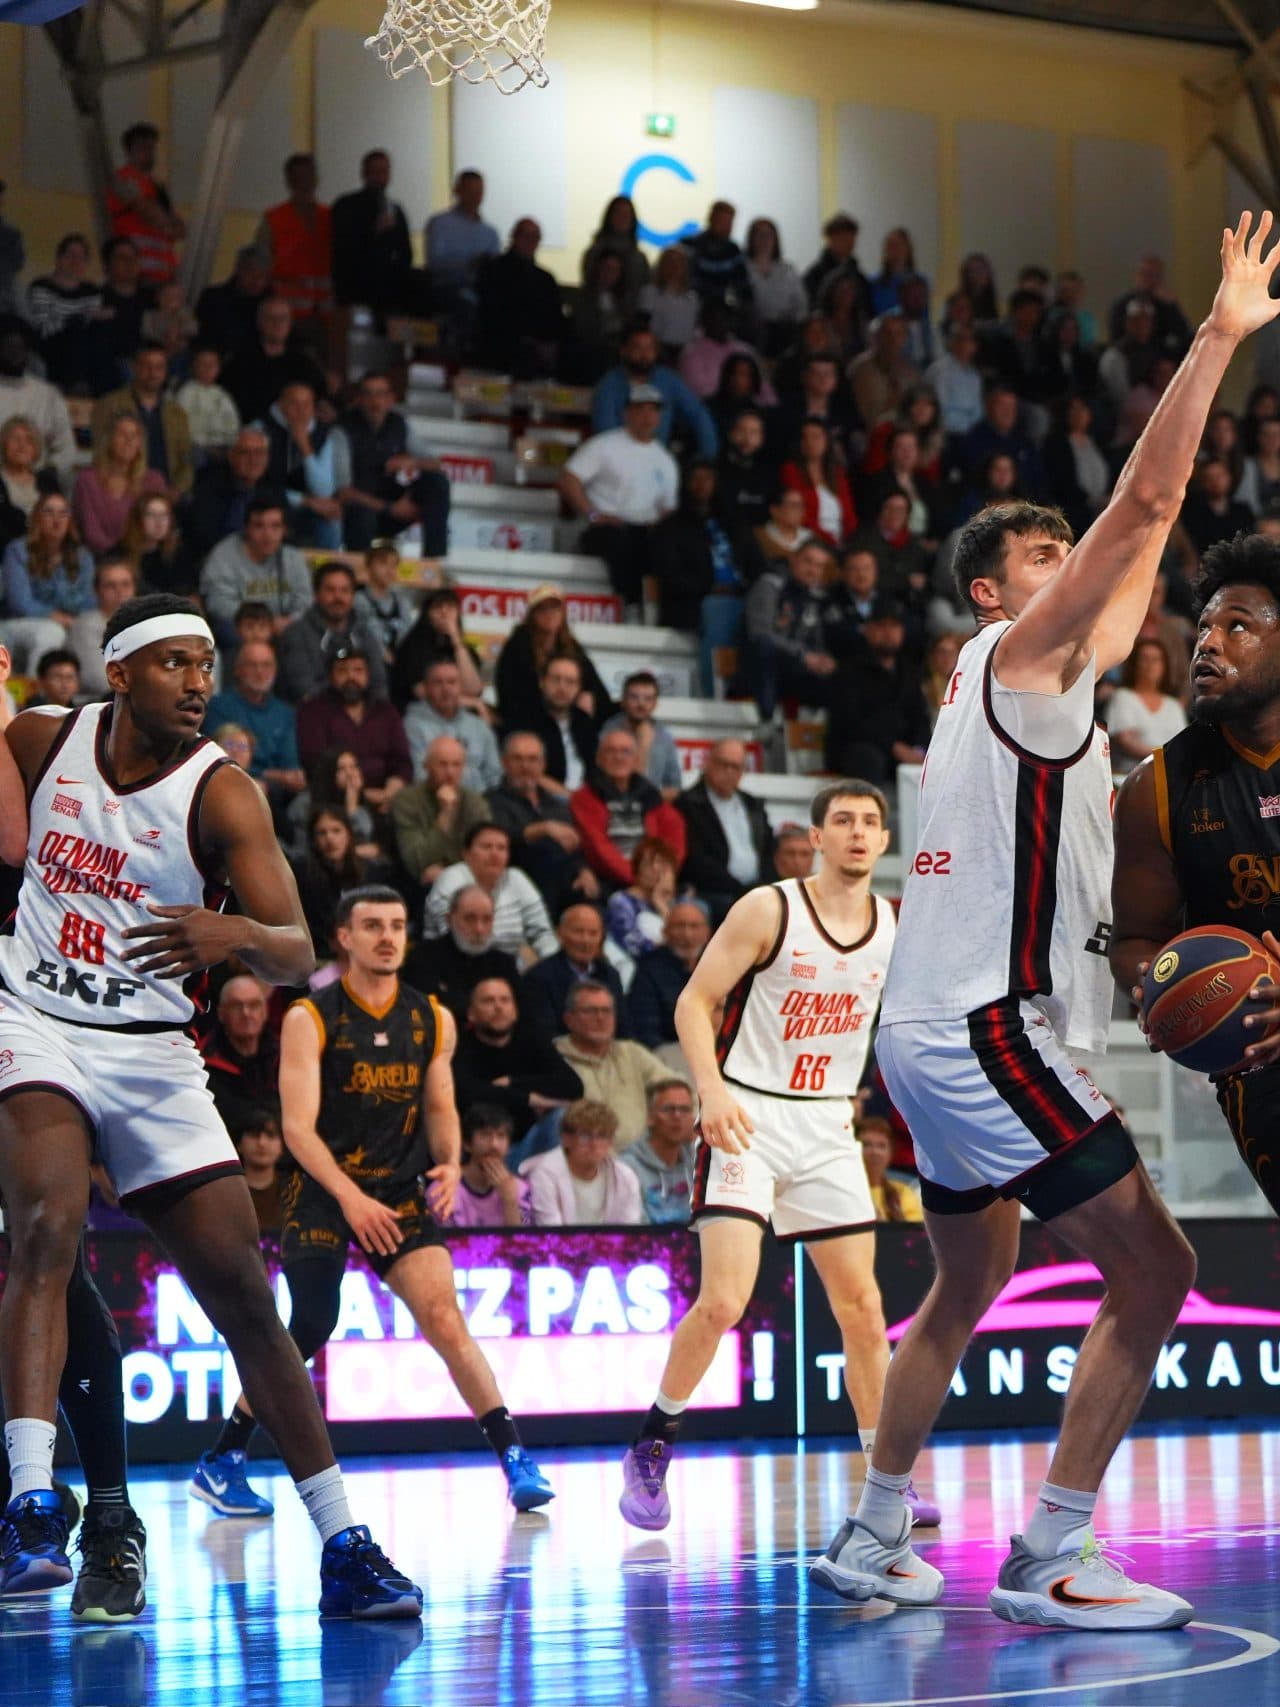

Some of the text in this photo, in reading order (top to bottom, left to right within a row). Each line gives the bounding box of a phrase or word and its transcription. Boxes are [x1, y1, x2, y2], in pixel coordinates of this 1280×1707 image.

[621, 154, 701, 247] C
[37, 830, 128, 880] DENAIN
[909, 850, 952, 875] ez
[43, 867, 151, 903] VOLTAIRE
[59, 911, 105, 965] 88
[26, 958, 146, 1007] SKF
[779, 989, 859, 1017] DENAIN
[783, 1012, 868, 1042] VOLTAIRE
[789, 1053, 832, 1091] 66
[527, 1263, 672, 1337] PAS
[752, 1332, 775, 1402] !
